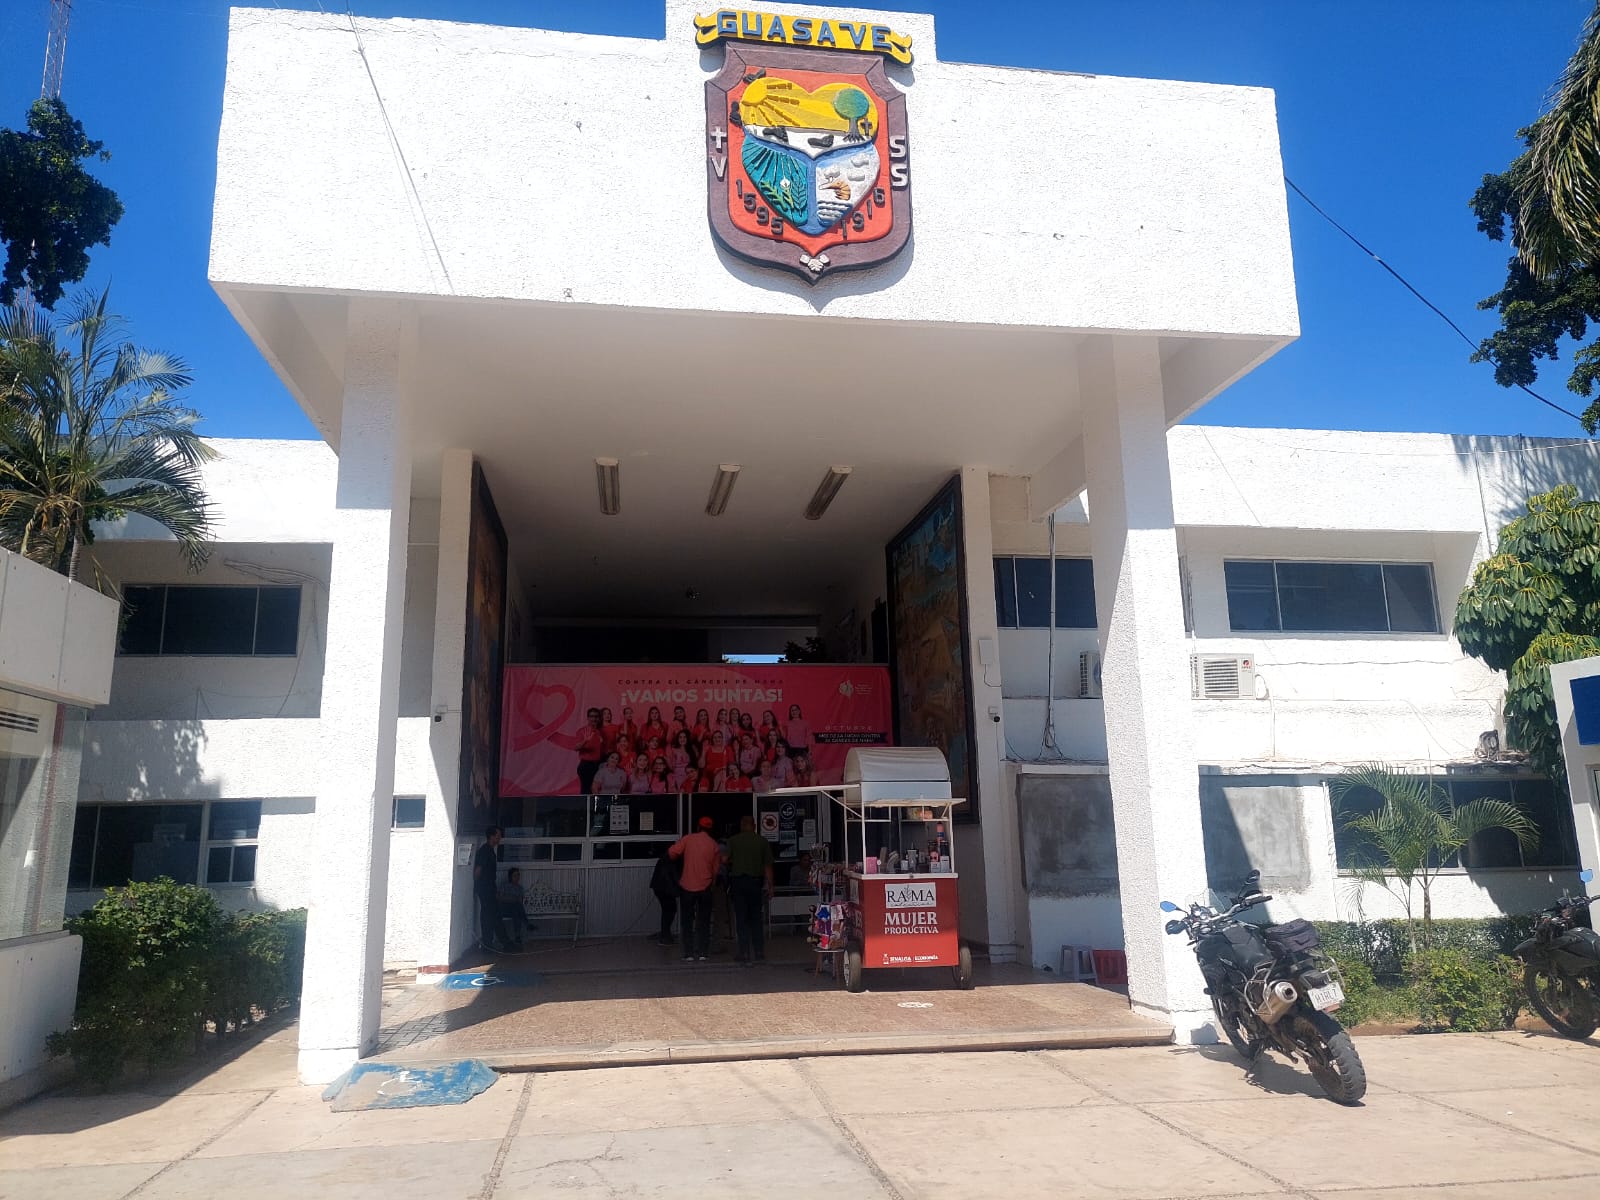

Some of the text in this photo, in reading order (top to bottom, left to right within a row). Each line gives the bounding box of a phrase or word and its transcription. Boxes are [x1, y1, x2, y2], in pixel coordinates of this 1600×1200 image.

[717, 11, 892, 51] GUASAVE
[736, 179, 784, 236] 1595
[841, 187, 886, 240] 1916
[621, 688, 783, 706] ¡VAMOS JUNTAS!
[887, 889, 934, 902] RAMA
[885, 912, 938, 926] MUJER
